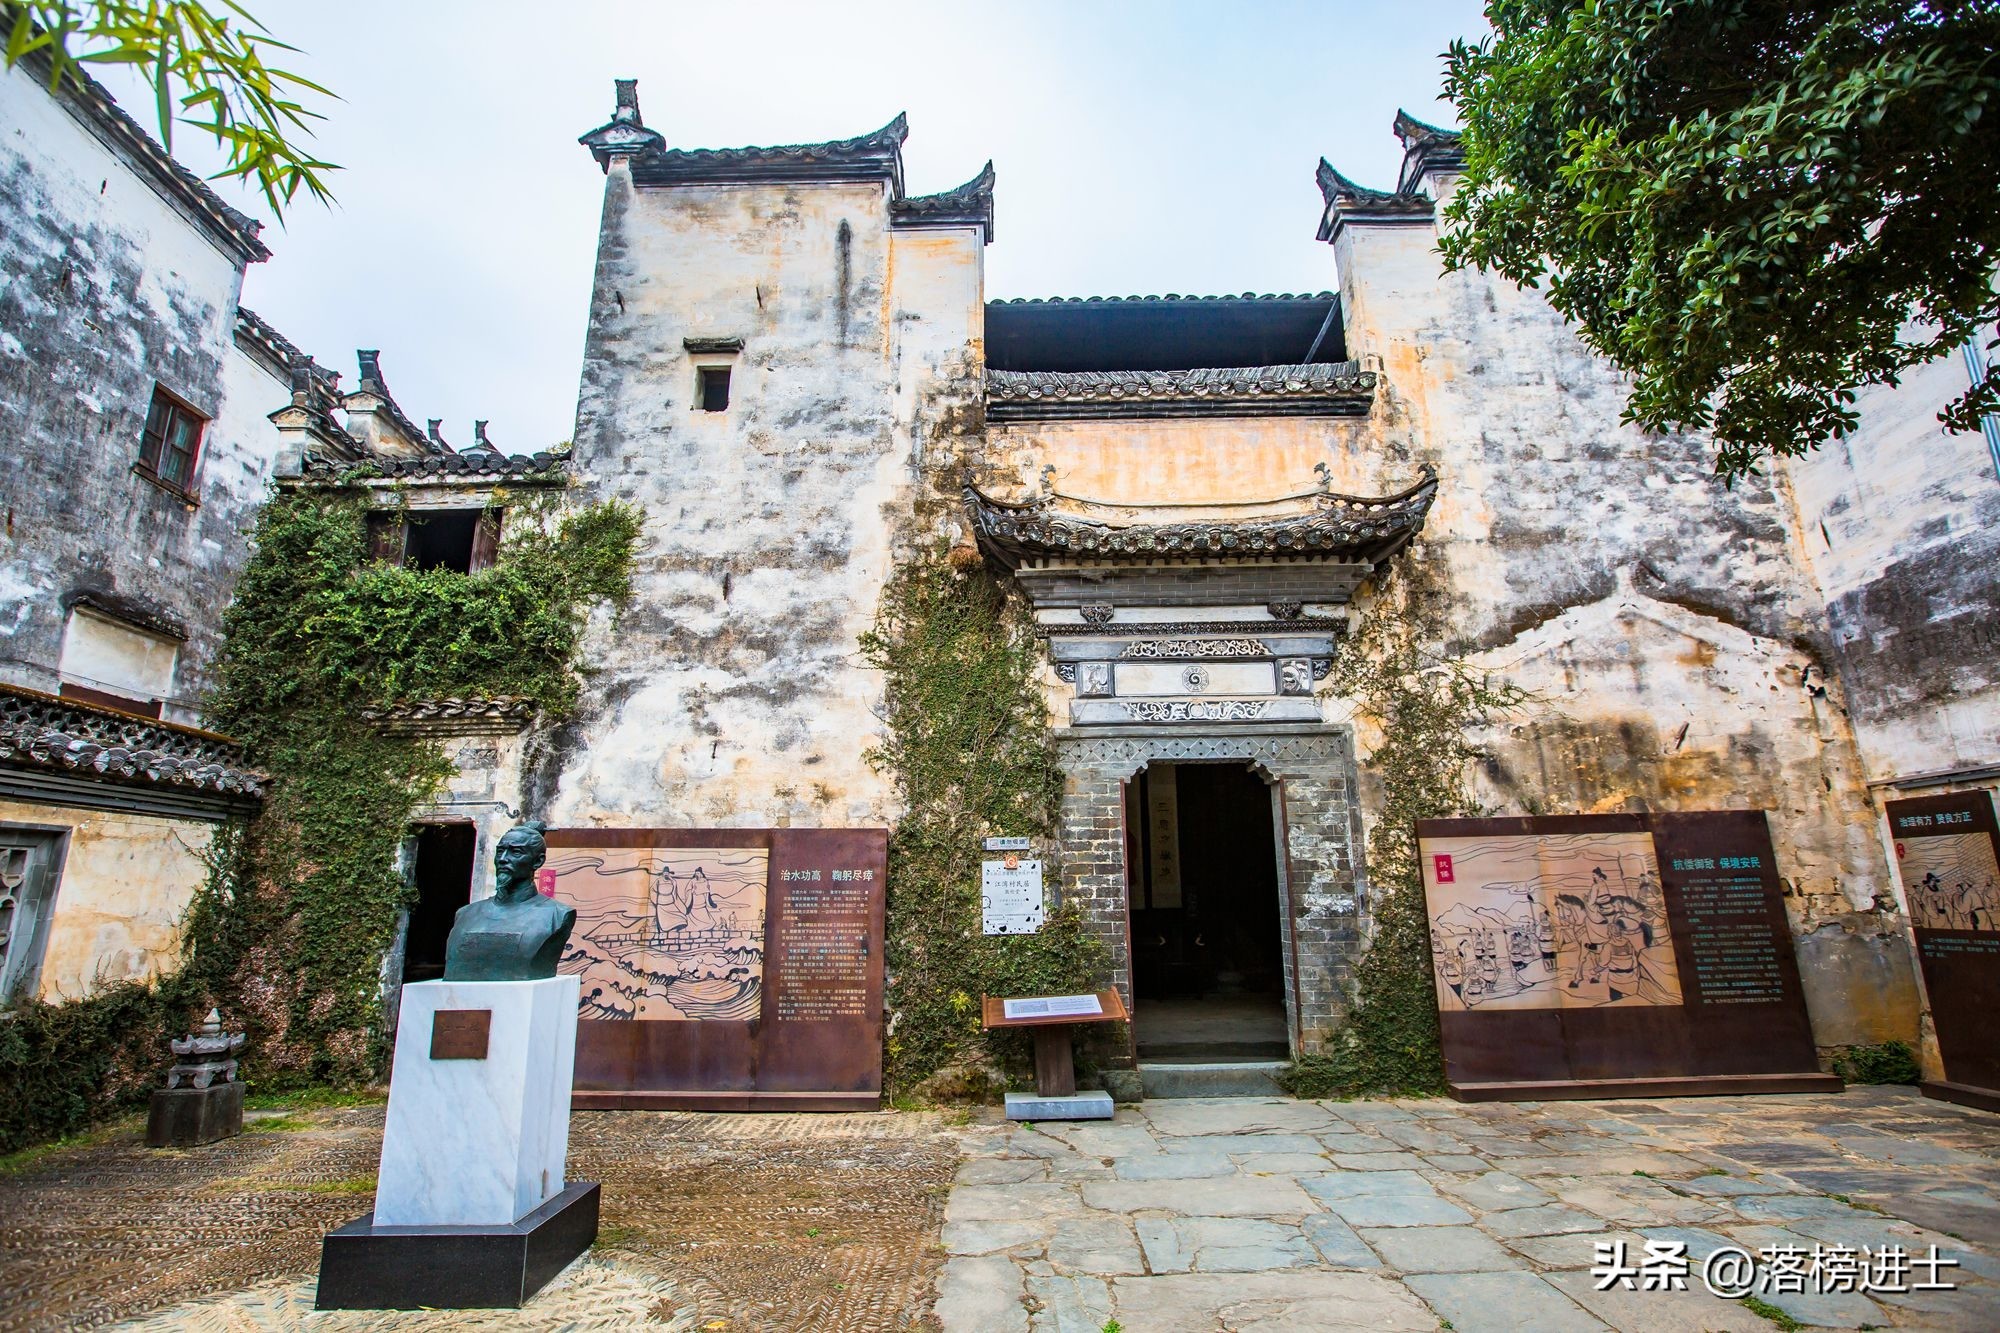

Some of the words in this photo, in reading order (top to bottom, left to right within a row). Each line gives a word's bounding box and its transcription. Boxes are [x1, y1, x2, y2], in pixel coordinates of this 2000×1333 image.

[1899, 815, 1932, 827] 治理有方
[1936, 812, 1973, 825] 贤良方正
[1439, 861, 1449, 878] 抗倭
[1672, 859, 1715, 871] 抗倭御敌
[1719, 857, 1761, 869] 保境安民
[780, 869, 821, 881] 治水功高
[832, 869, 873, 882] 鞠躬尽瘁
[542, 875, 552, 892] 治水
